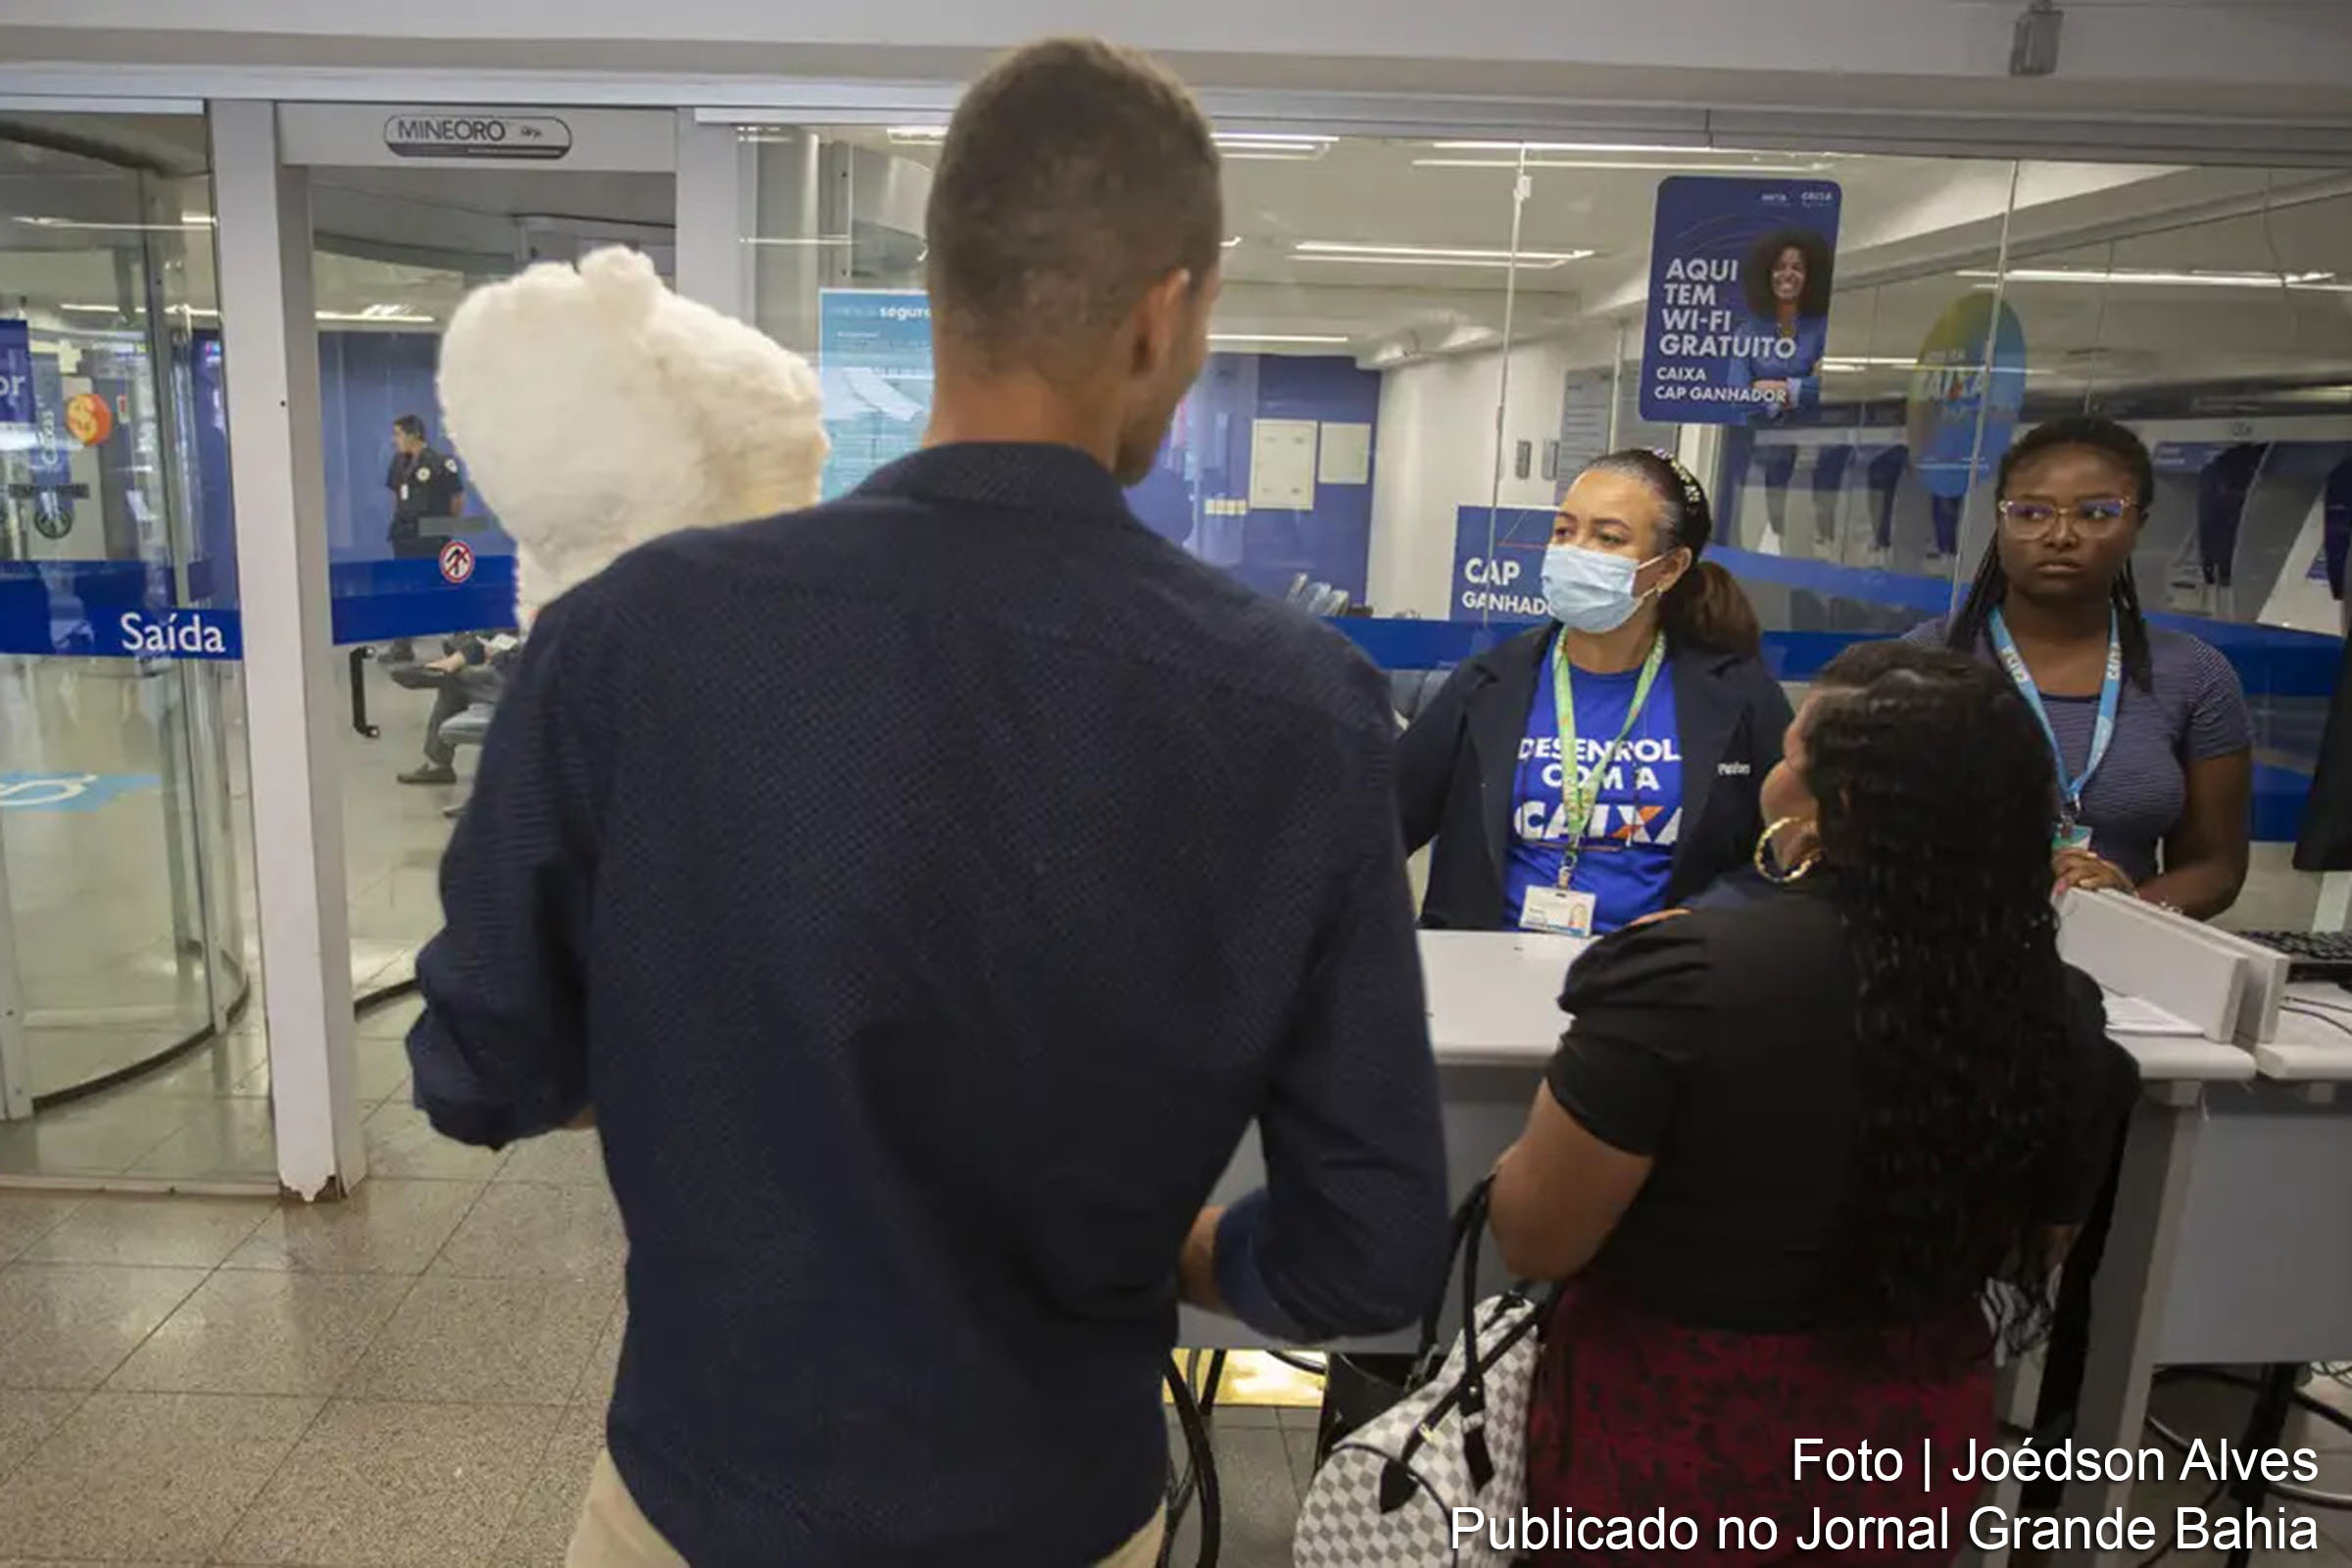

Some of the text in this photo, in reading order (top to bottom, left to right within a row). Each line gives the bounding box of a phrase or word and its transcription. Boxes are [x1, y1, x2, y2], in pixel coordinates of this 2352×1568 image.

[398, 121, 506, 141] MINEORO
[1667, 258, 1739, 281] AQUI
[1664, 283, 1715, 306] TEM
[1662, 309, 1732, 332] WI-FI
[1659, 334, 1796, 359] GRATUITO
[1656, 368, 1706, 381] CAIXA
[1654, 387, 1787, 403] CAP GANHADOR
[1464, 557, 1520, 586] CAP
[1462, 591, 1551, 615] GANHAD
[121, 612, 226, 653] Saída
[1636, 765, 1660, 791] A
